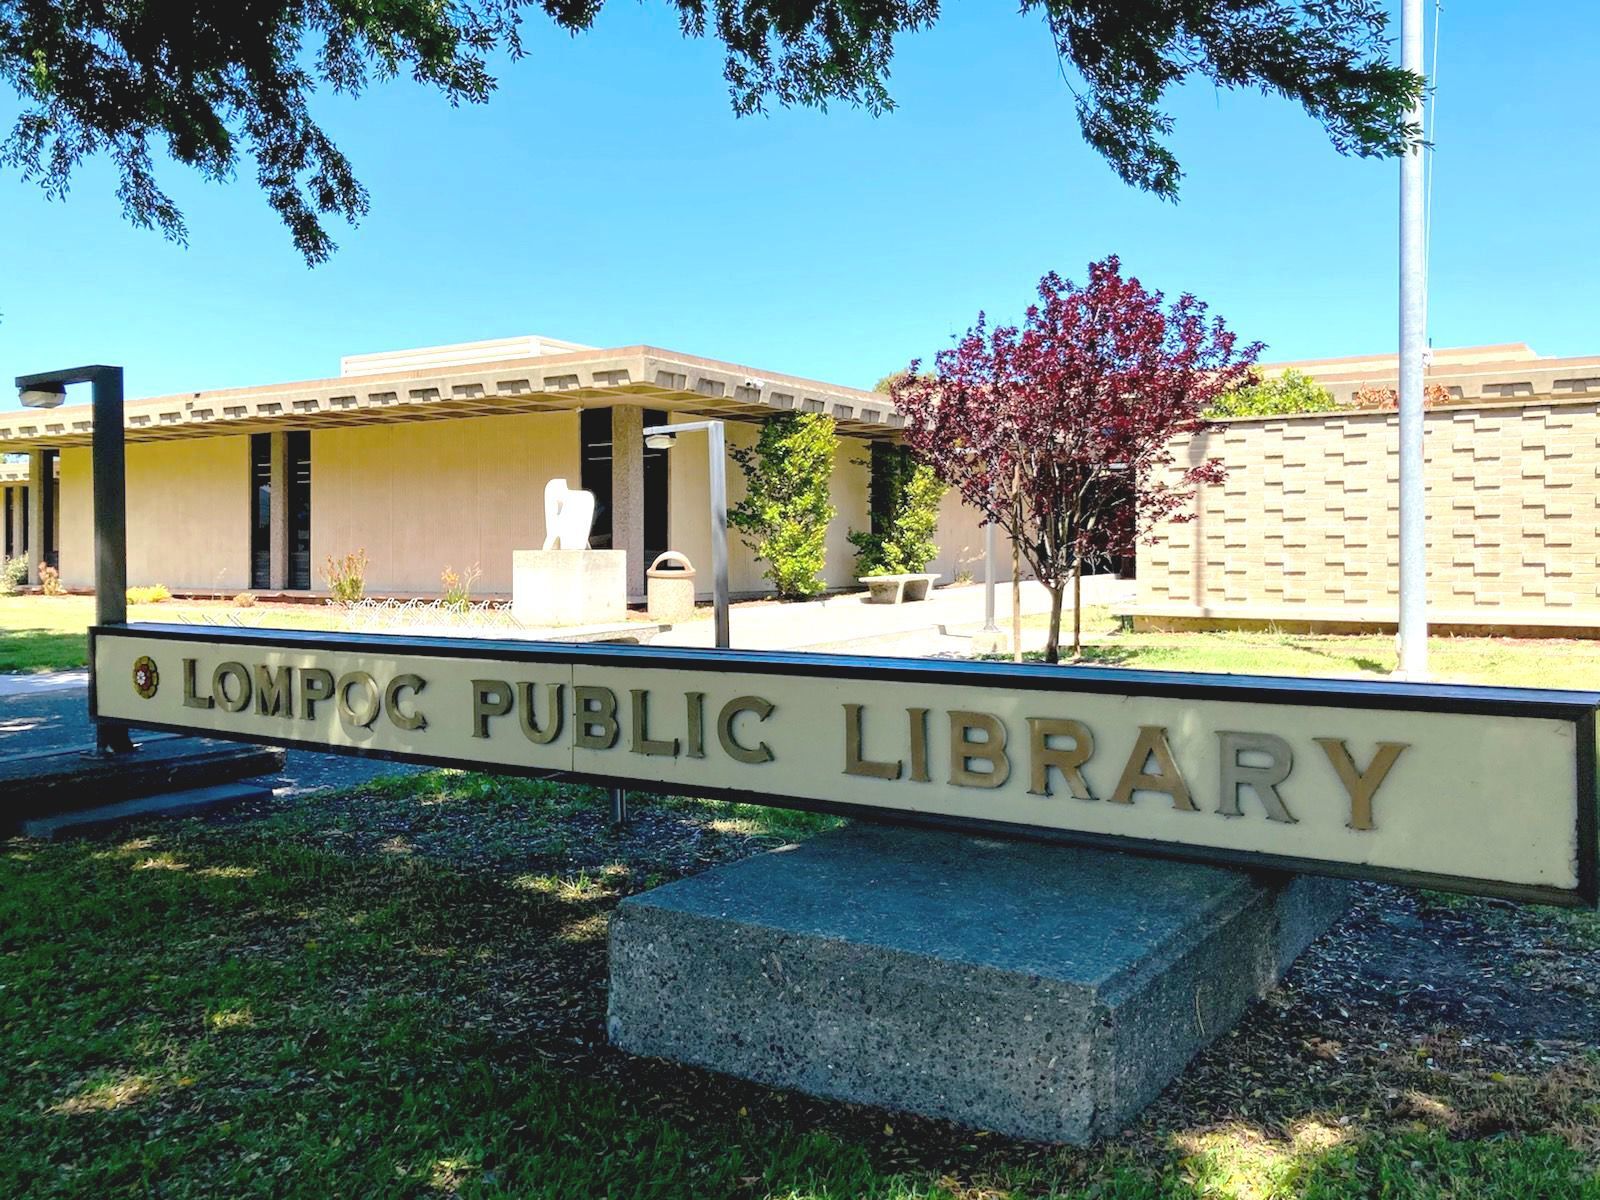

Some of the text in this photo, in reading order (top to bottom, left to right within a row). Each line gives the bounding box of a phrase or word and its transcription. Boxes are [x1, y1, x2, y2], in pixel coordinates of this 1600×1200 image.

[182, 658, 1411, 831] LOMPOC PUBLIC LIBRARY
